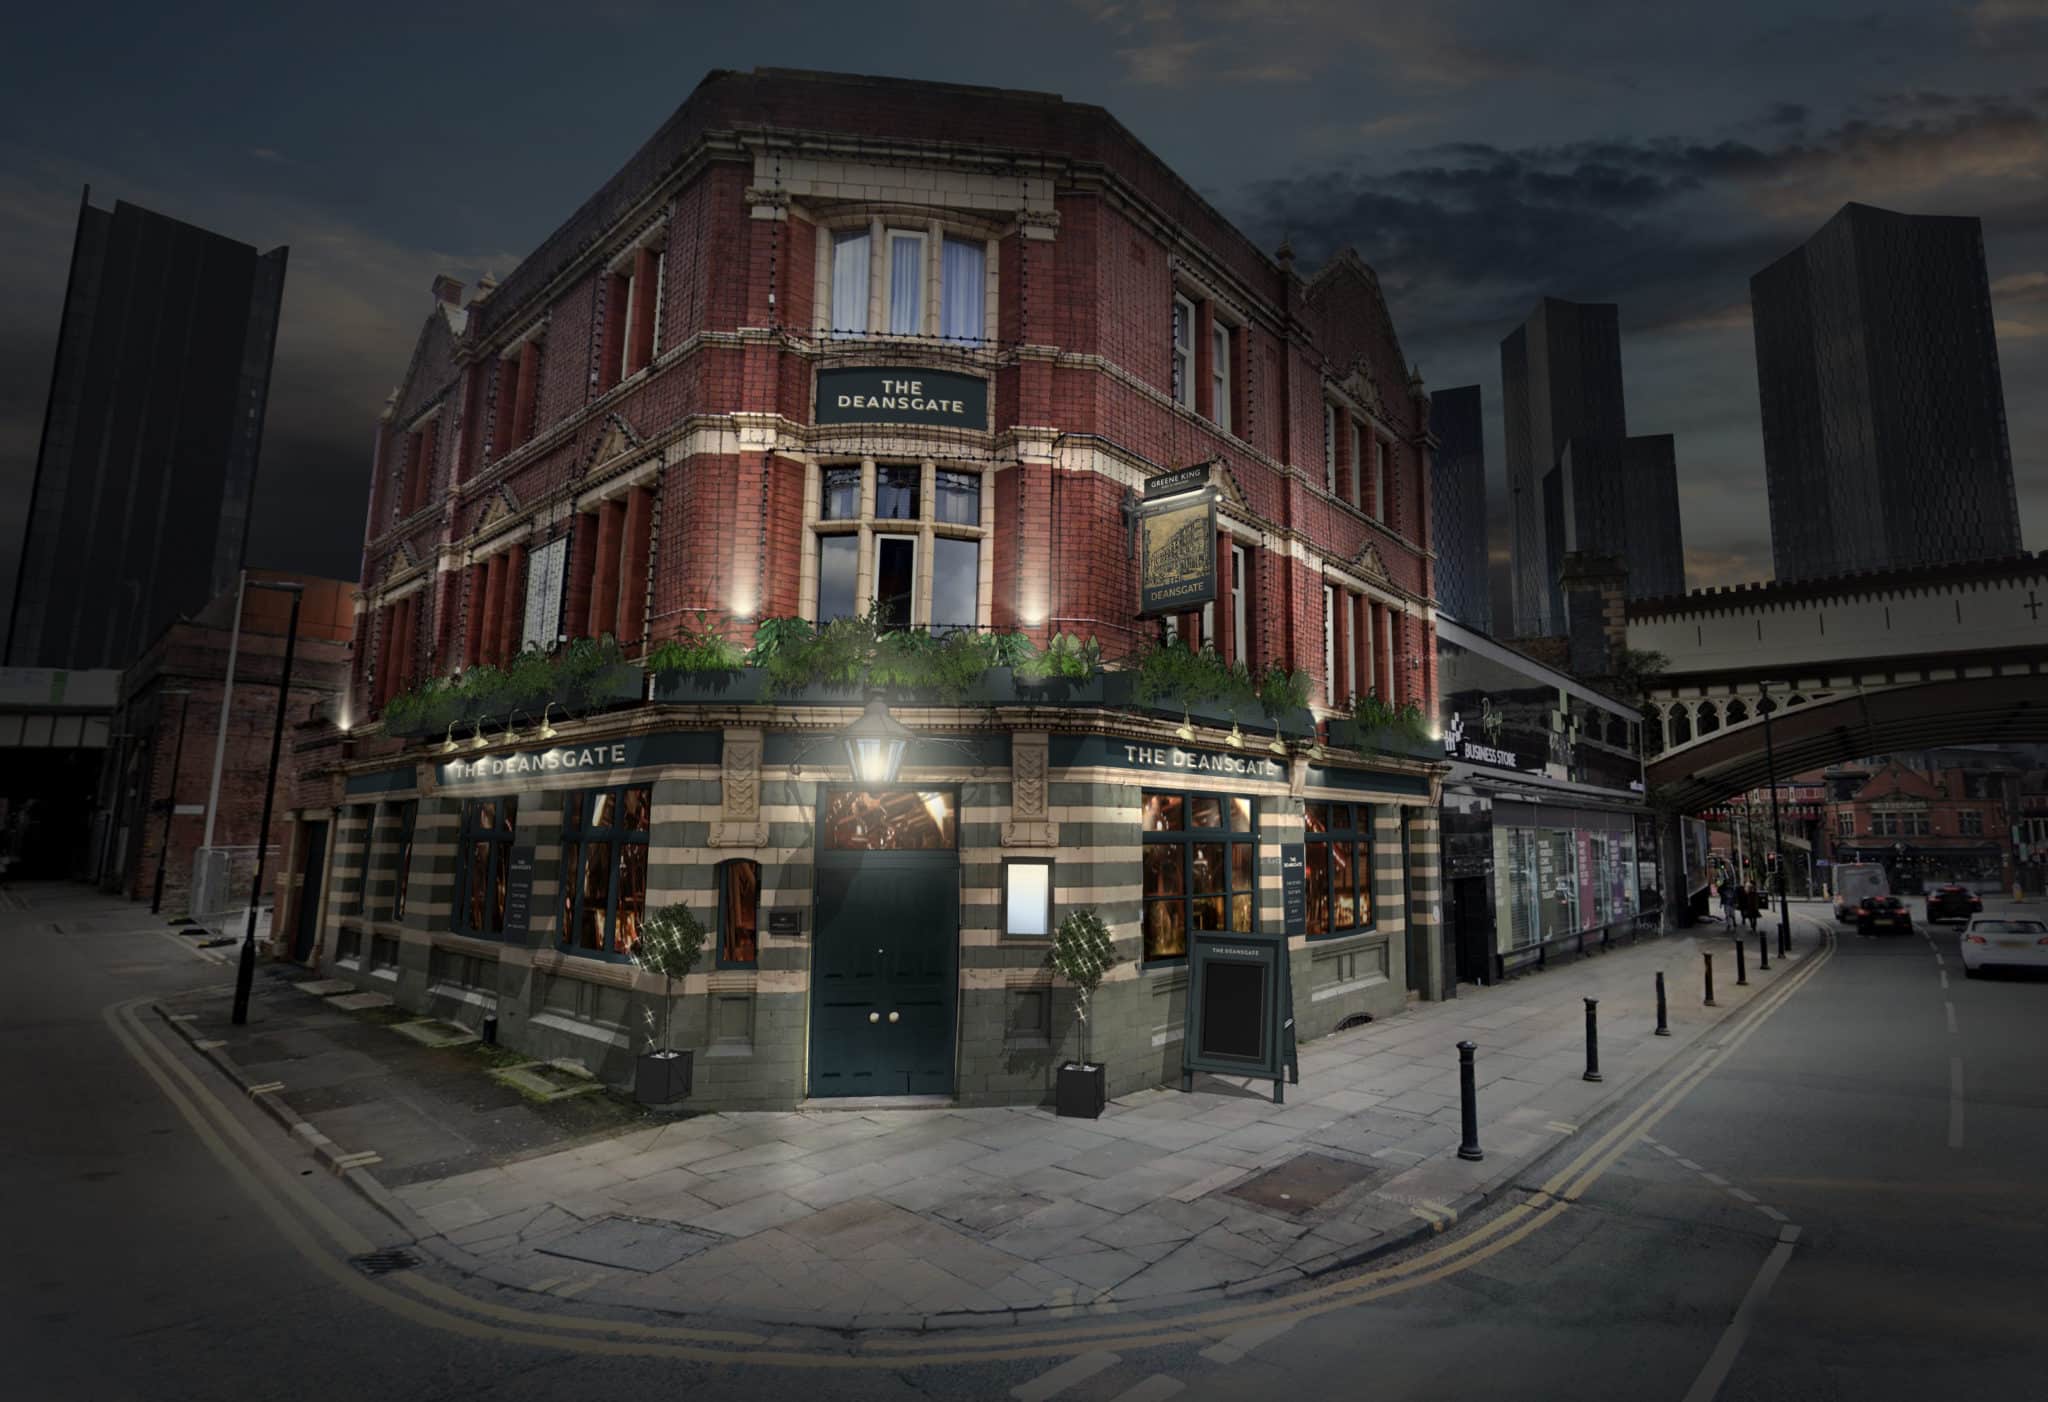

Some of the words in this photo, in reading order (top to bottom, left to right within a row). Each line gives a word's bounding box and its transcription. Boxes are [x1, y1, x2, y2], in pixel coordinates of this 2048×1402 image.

[881, 380, 923, 395] THE
[837, 395, 965, 413] DEANSGATE
[1151, 476, 1179, 488] GREENE
[1180, 469, 1201, 481] KING
[1151, 582, 1204, 601] DEANSGATE
[455, 761, 488, 779] THE
[492, 744, 626, 775] DEANSGATE
[1123, 745, 1166, 765] THE
[1172, 750, 1275, 776] DEANSGATE
[1464, 742, 1496, 765] BUSINESS
[1496, 749, 1517, 768] STORE
